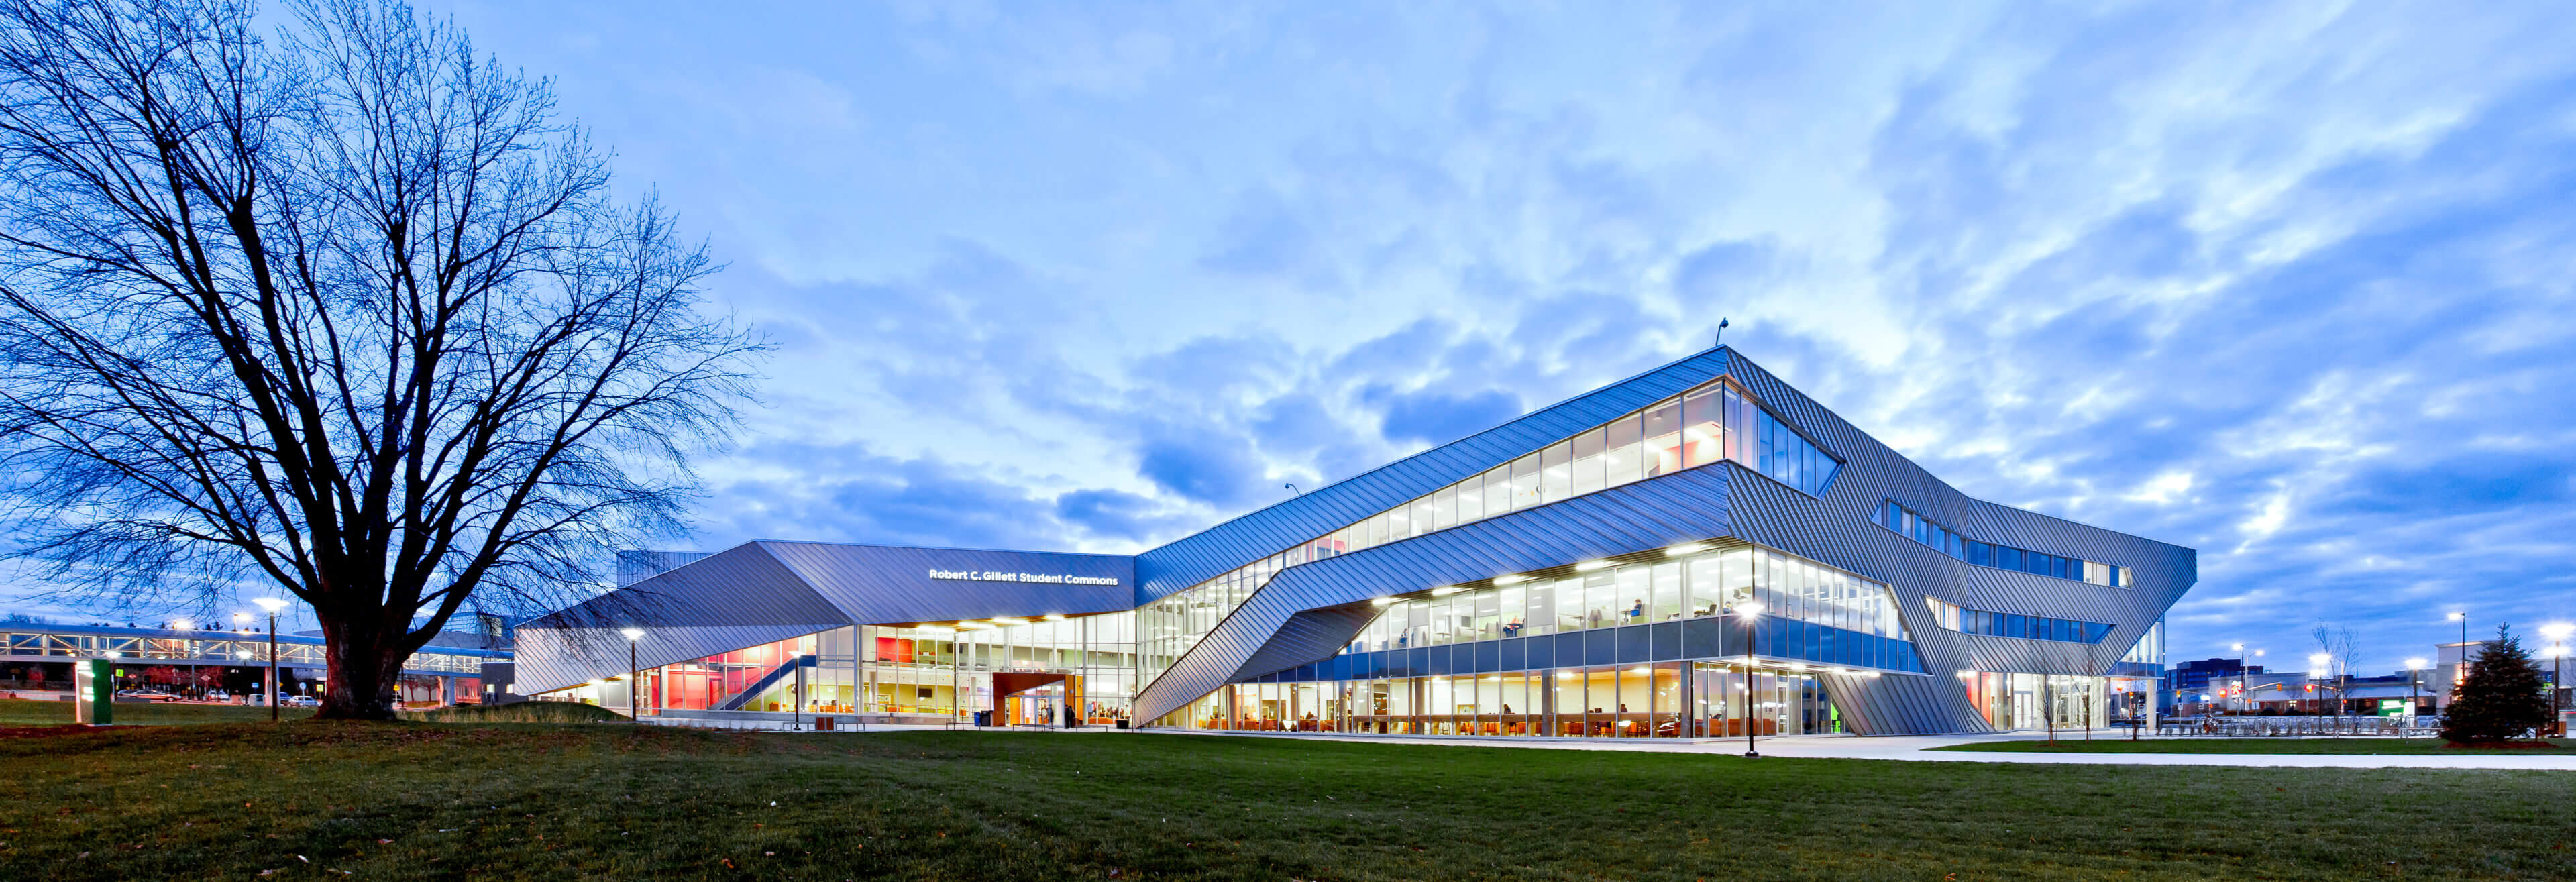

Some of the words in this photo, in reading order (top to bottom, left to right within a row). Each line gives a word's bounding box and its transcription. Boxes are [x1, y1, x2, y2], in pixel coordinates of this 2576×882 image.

[929, 569, 968, 580] Robert
[970, 571, 981, 580] C.
[983, 571, 1017, 582] Gillett
[1019, 573, 1063, 584] Student
[1065, 574, 1118, 586] Commons
